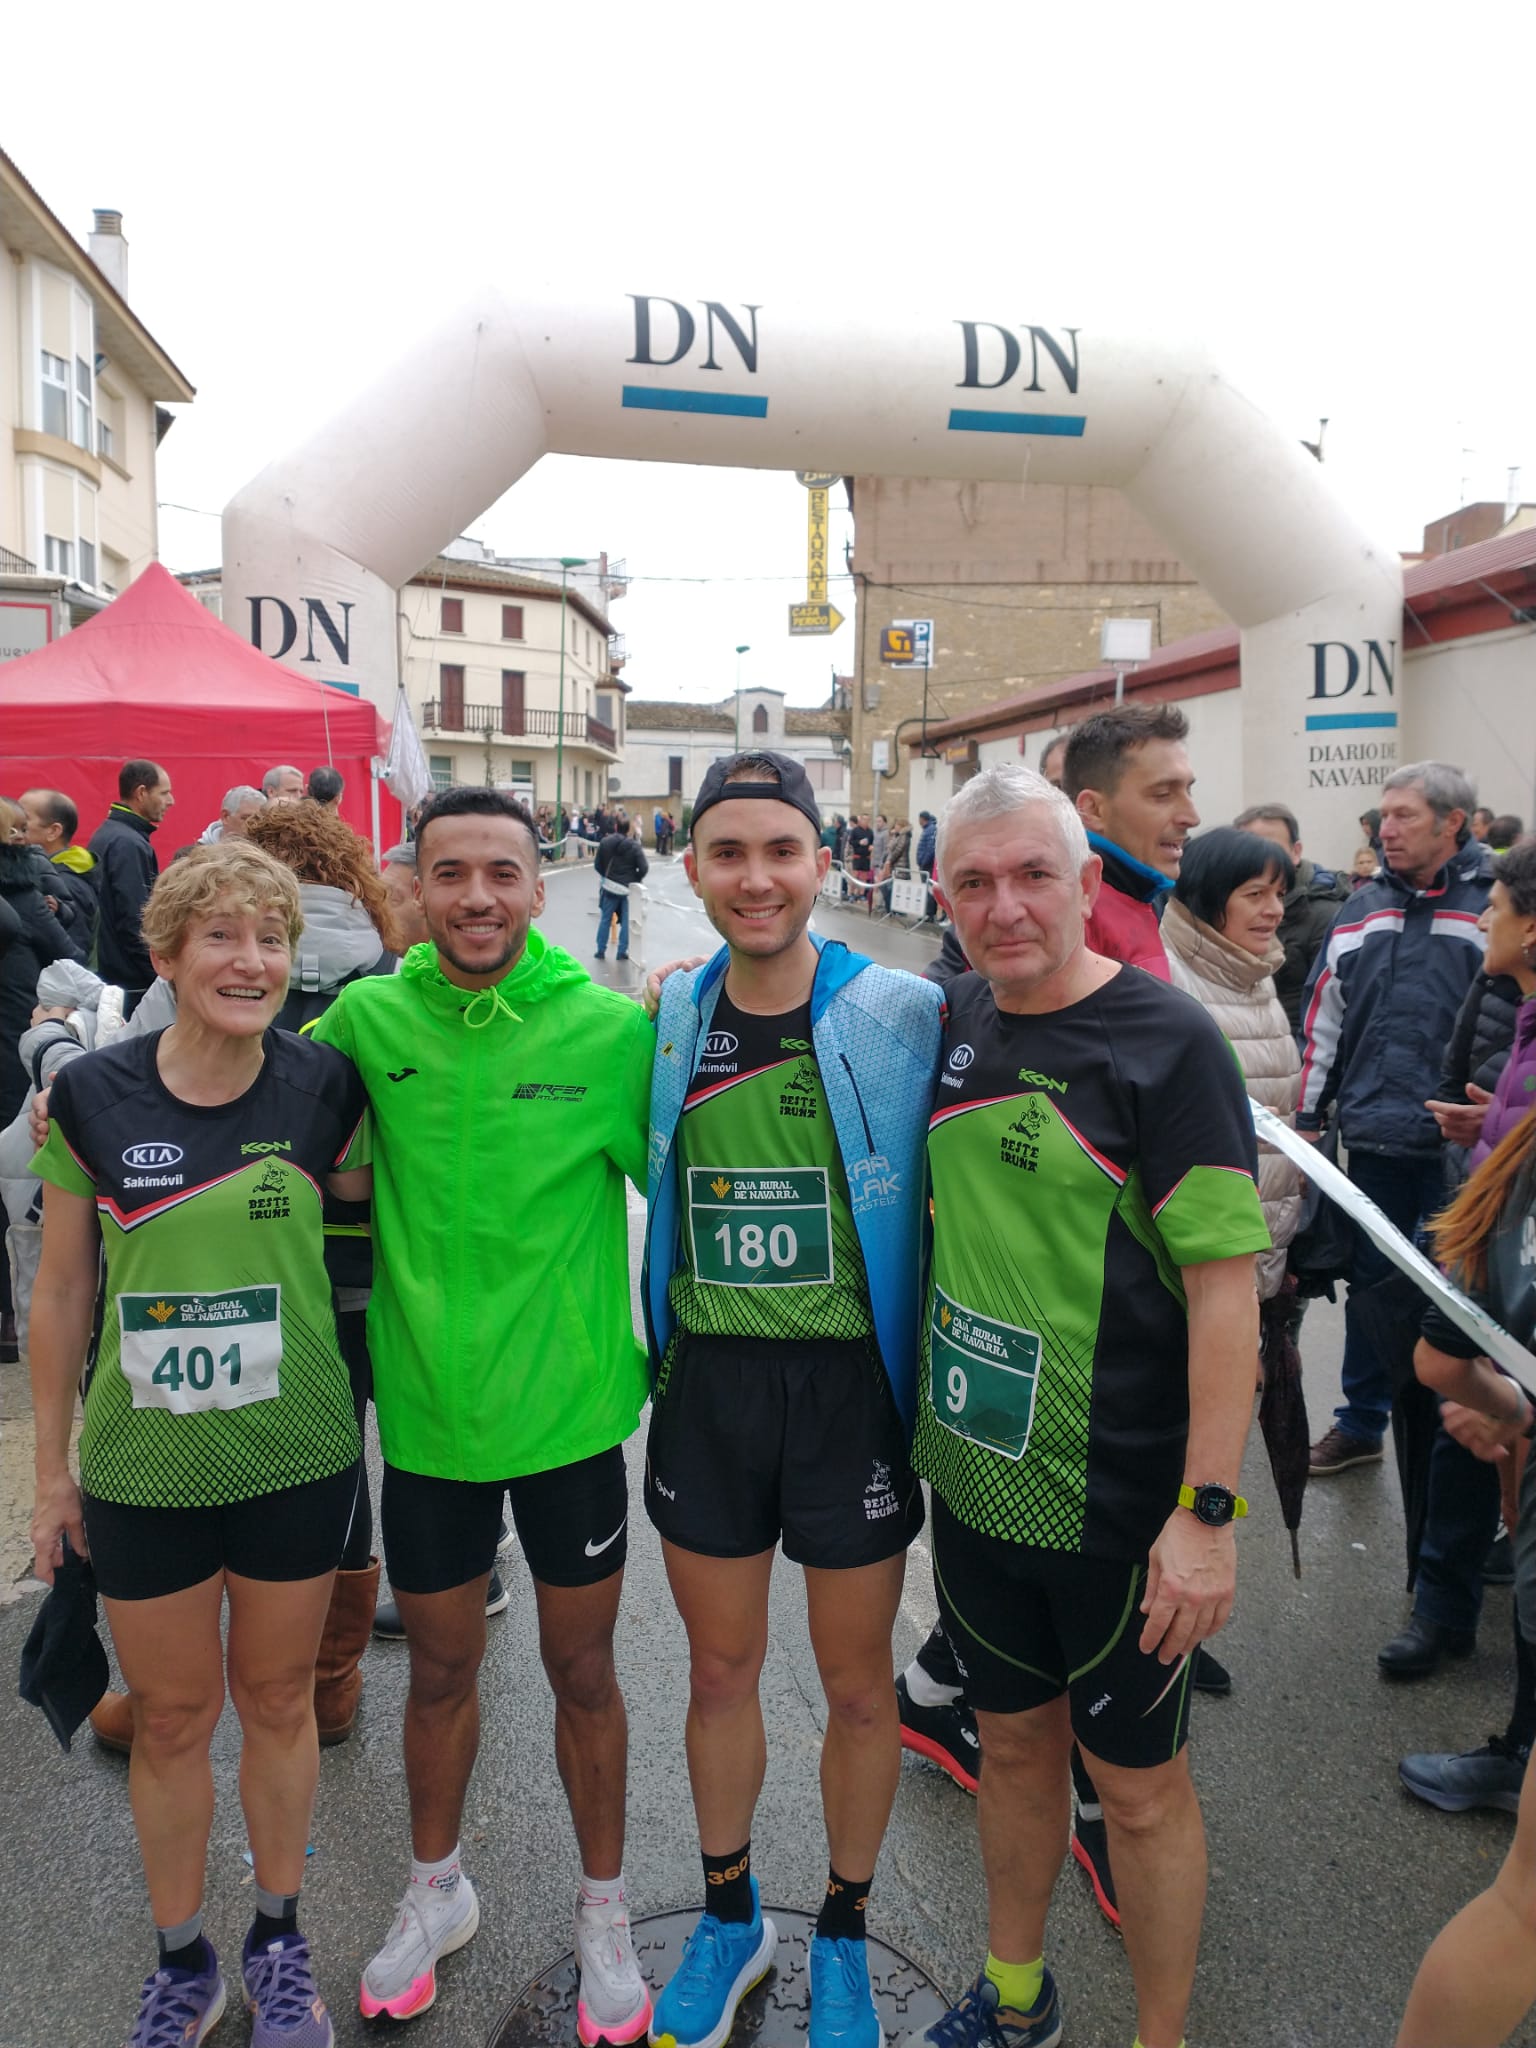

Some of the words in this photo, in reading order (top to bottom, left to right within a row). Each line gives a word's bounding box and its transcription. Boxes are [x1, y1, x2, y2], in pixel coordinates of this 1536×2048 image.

[625, 293, 764, 373] DN
[952, 319, 1082, 394] DN
[245, 596, 355, 665] DN
[1307, 639, 1398, 699] DN
[1309, 743, 1378, 763] DIARIO
[1309, 766, 1396, 788] NAVARR
[780, 1037, 813, 1050] KO
[697, 1062, 738, 1073] akimóvil
[952, 1050, 969, 1066] KIA
[780, 1095, 817, 1107] BESTE
[132, 1148, 173, 1163] KIA
[1000, 1136, 1040, 1159] BESTE
[123, 1174, 183, 1188] Sakimóvil
[733, 1180, 757, 1191] CAJA
[760, 1180, 793, 1190] RURAL
[249, 1196, 290, 1209] BESTE
[734, 1190, 747, 1199] DE
[749, 1190, 800, 1199] NAVARRA
[715, 1223, 798, 1268] 180
[181, 1314, 196, 1322] DE
[198, 1308, 249, 1321] NAVARRA
[208, 1300, 243, 1312] RURAL
[951, 1325, 961, 1340] DE
[962, 1334, 1009, 1359] NAVARRA
[952, 1316, 970, 1334] CAJA
[972, 1326, 1004, 1347] RURAL
[152, 1343, 242, 1392] 401
[946, 1365, 968, 1414] 9
[863, 1490, 897, 1509] BESTE
[1089, 1692, 1112, 1717] KON
[707, 1855, 749, 1886] 360
